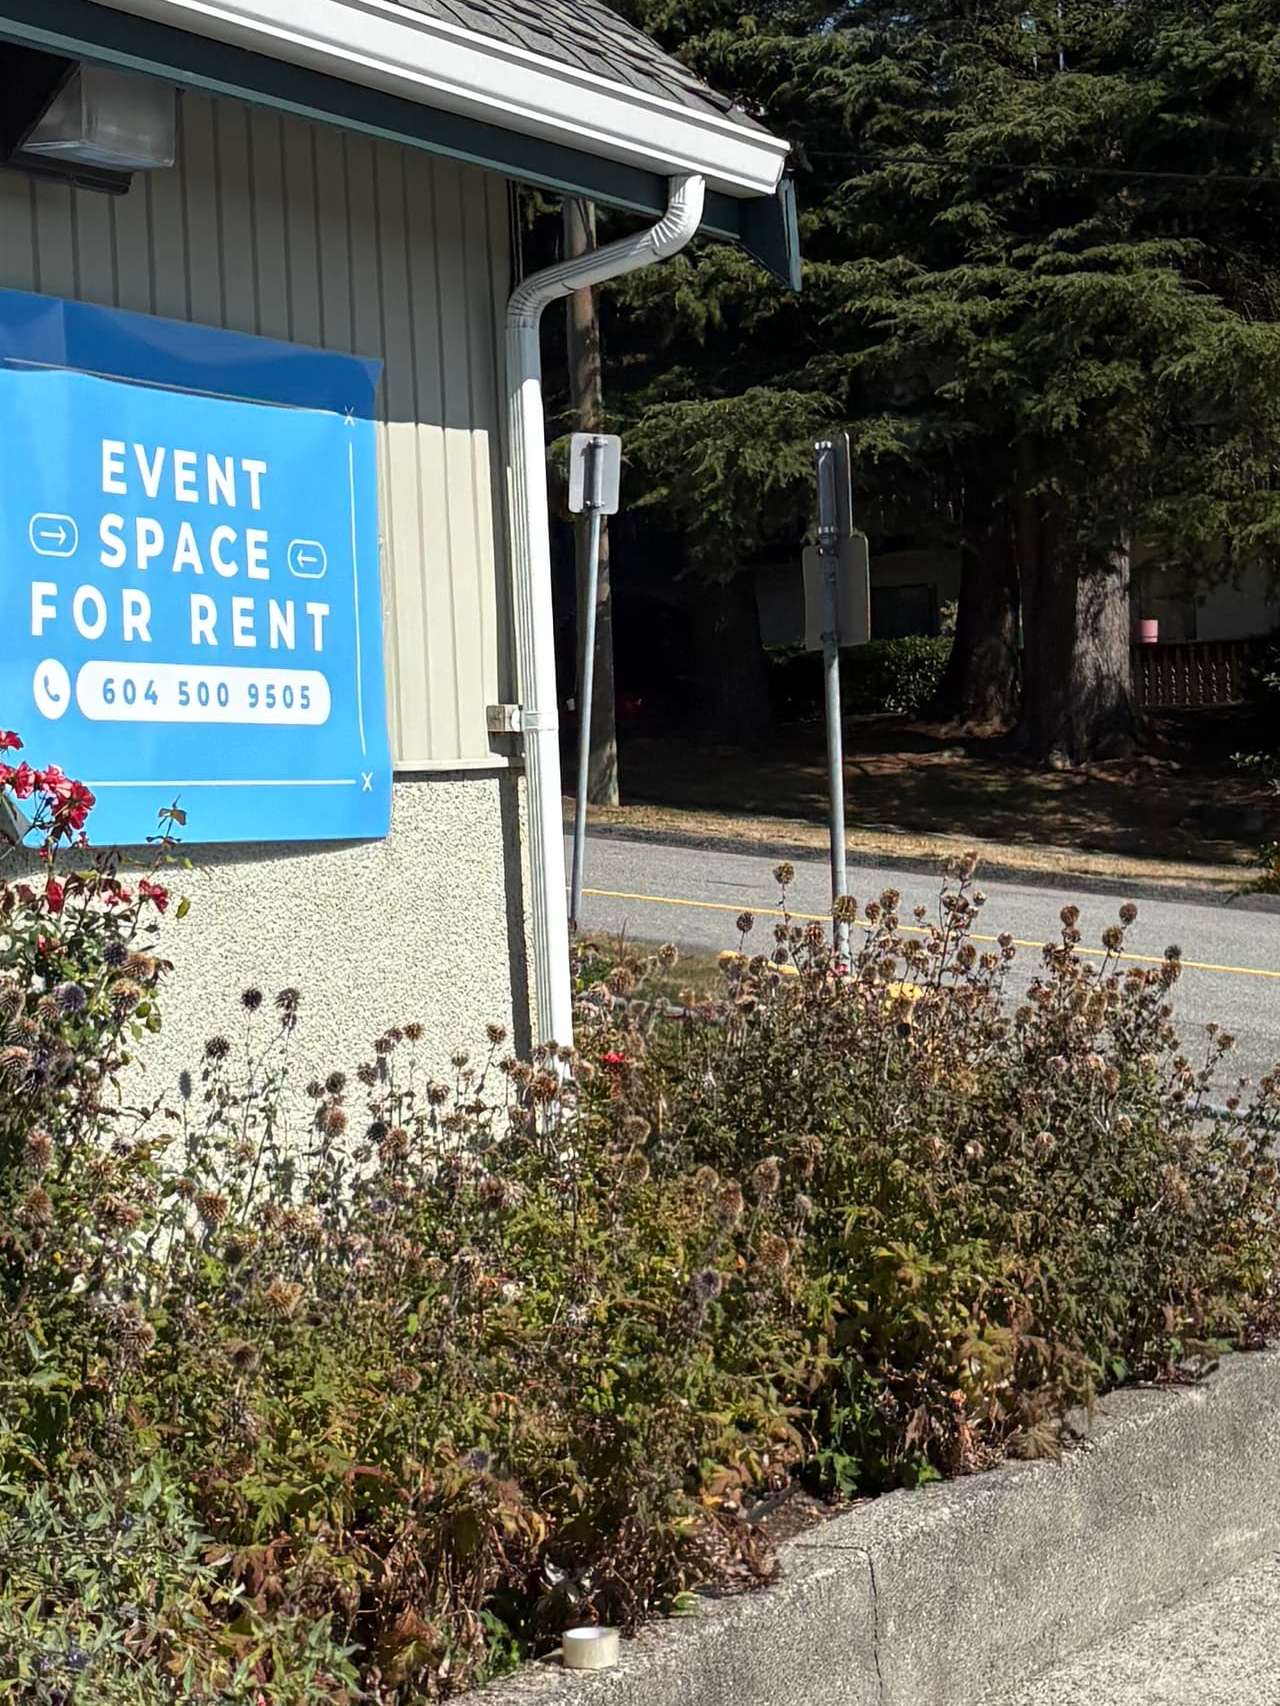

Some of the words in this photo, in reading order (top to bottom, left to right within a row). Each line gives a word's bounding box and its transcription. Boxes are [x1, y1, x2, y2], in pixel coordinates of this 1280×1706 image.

[101, 438, 267, 510] EVENT
[99, 513, 271, 580] SPACE
[31, 581, 152, 643] FOR
[190, 593, 331, 652] RENT
[102, 678, 158, 706] 604
[178, 680, 229, 708] 500
[247, 683, 311, 710] 9505
